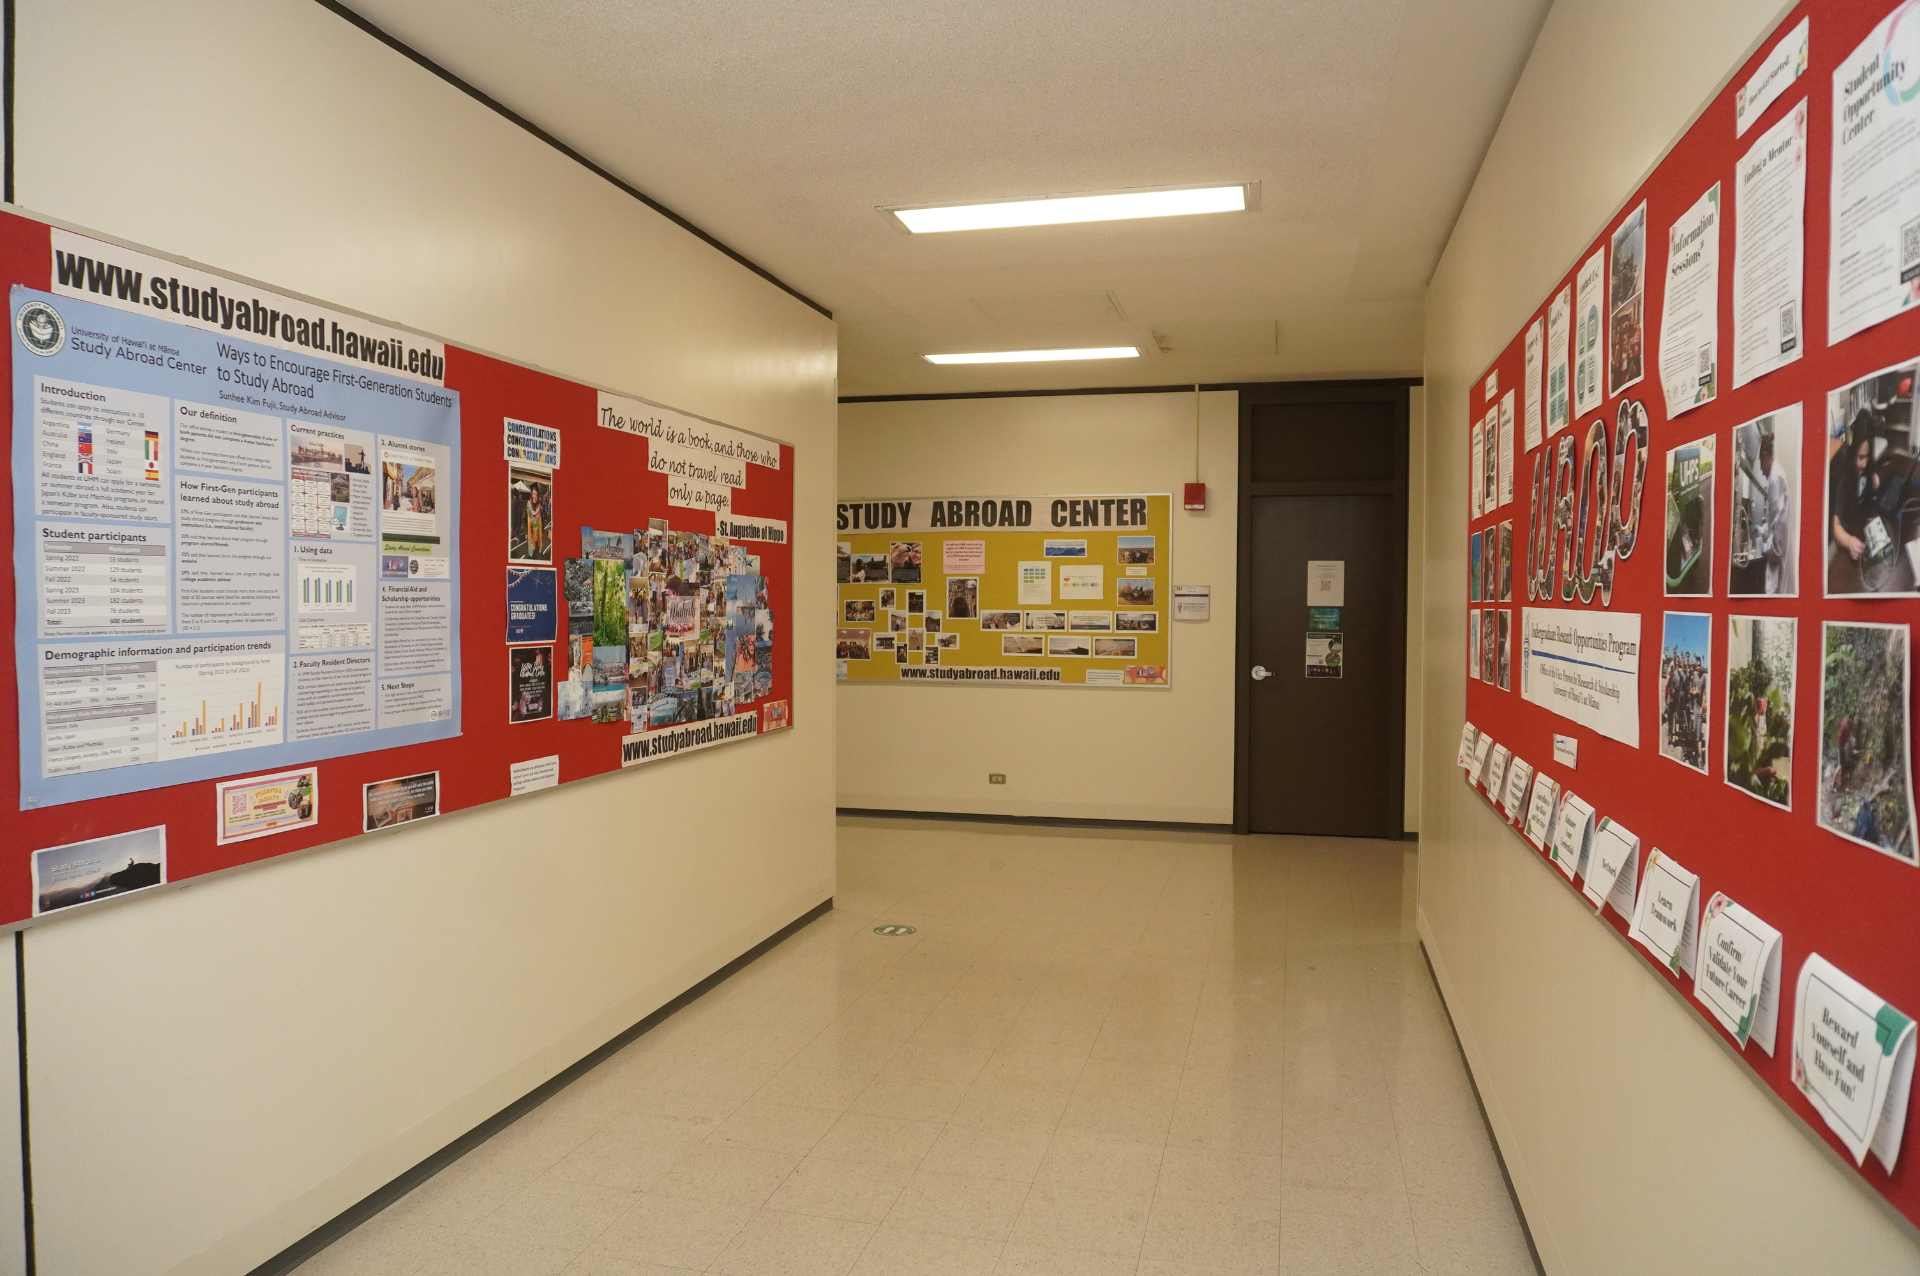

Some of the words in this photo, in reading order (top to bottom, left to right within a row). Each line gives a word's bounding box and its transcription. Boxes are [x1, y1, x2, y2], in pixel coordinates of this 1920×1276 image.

[1770, 54, 1790, 81] Started!
[1844, 54, 1879, 100] Student
[1843, 60, 1905, 123] Opportunity
[1842, 109, 1874, 145] Center
[1768, 136, 1794, 161] Mentor
[1672, 212, 1714, 258] Information
[55, 249, 444, 381] www.studyabroad.hawaii.edu
[71, 326, 109, 342] University
[112, 334, 120, 343] of
[149, 342, 156, 350] at
[71, 337, 112, 359] Study
[116, 346, 163, 367] Abroad
[167, 357, 207, 375] Center
[216, 342, 250, 364] Ways
[254, 352, 266, 367] to
[270, 354, 330, 384] Encourage
[332, 369, 412, 400] First-Generation
[415, 388, 452, 408] Students
[217, 366, 230, 382] to
[234, 368, 269, 392] Study
[272, 376, 314, 398] Abroad
[41, 382, 106, 402] Introduction
[180, 406, 198, 416] Our
[200, 410, 238, 424] definition
[219, 390, 245, 404] Sunhee
[246, 396, 260, 406] Kim
[279, 401, 298, 414] Study
[299, 404, 322, 417] Abroad
[324, 409, 346, 421] Advisor
[42, 420, 70, 429] Argentina
[106, 428, 130, 437] Germany
[42, 430, 68, 438] Australia
[106, 438, 125, 446] Ireland
[290, 424, 316, 435] Current
[318, 430, 344, 440] practices
[508, 422, 556, 442] CONGRATULATIONS
[601, 407, 626, 429] The
[630, 417, 664, 438] world
[666, 426, 677, 443] is
[678, 432, 686, 444] a
[688, 428, 714, 452] book,
[714, 440, 736, 456] and
[736, 442, 760, 462] those
[760, 452, 777, 467] who
[42, 440, 58, 448] China
[106, 448, 118, 456] Italy
[388, 440, 408, 450] Alumni
[409, 444, 426, 452] stories
[42, 451, 66, 460] England
[106, 458, 122, 466] Japan
[43, 461, 62, 469] France
[650, 451, 667, 470] do
[669, 460, 686, 474] not
[688, 462, 718, 482] travel
[720, 470, 743, 486] read
[1680, 458, 1699, 487] UHPS
[180, 481, 198, 490] How
[200, 483, 236, 494] First-Gen
[238, 488, 278, 498] participants
[670, 483, 692, 506] only
[696, 490, 704, 502] a
[704, 490, 730, 512] page.
[180, 494, 210, 503] learned
[212, 496, 233, 505] about
[235, 499, 254, 508] study
[256, 500, 279, 508] abroad
[837, 502, 912, 530] STUDY
[930, 500, 1032, 528] ABROAD
[1051, 498, 1147, 527] CENTER
[42, 528, 85, 540] Student
[88, 532, 146, 544] participants
[730, 522, 760, 540] Augustine
[762, 526, 768, 540] of
[768, 526, 784, 542] Hippo
[45, 554, 64, 562] Spring
[118, 556, 140, 564] students
[300, 546, 318, 555] Using
[120, 566, 142, 574] students
[65, 586, 79, 594] 2023
[510, 604, 548, 612] CONGRATULATIONS
[510, 612, 536, 620] GRADUATES!
[45, 648, 116, 661] Demographic
[118, 646, 172, 656] information
[175, 645, 191, 654] and
[194, 643, 245, 655] participation
[248, 641, 272, 650] trends
[1574, 628, 1608, 653] Opportunities
[1608, 632, 1636, 661] Program
[300, 660, 320, 668] Faculty
[901, 667, 1060, 682] www.studyabroad.hawaii.edu
[622, 714, 757, 762] www.studyabroad.hawaii.edu
[1602, 858, 1618, 878] Network
[1658, 890, 1672, 911] Learn
[1650, 903, 1677, 932] Teamwork
[1708, 946, 1732, 976] Validate
[1732, 964, 1748, 990] Your
[1706, 964, 1727, 997] Future
[1726, 980, 1747, 1010] Career
[1822, 1006, 1860, 1049] Reward
[1811, 1023, 1848, 1066] Yourself
[1846, 1058, 1864, 1083] and
[1814, 1048, 1834, 1081] Have
[1834, 1072, 1856, 1102] Fun!
